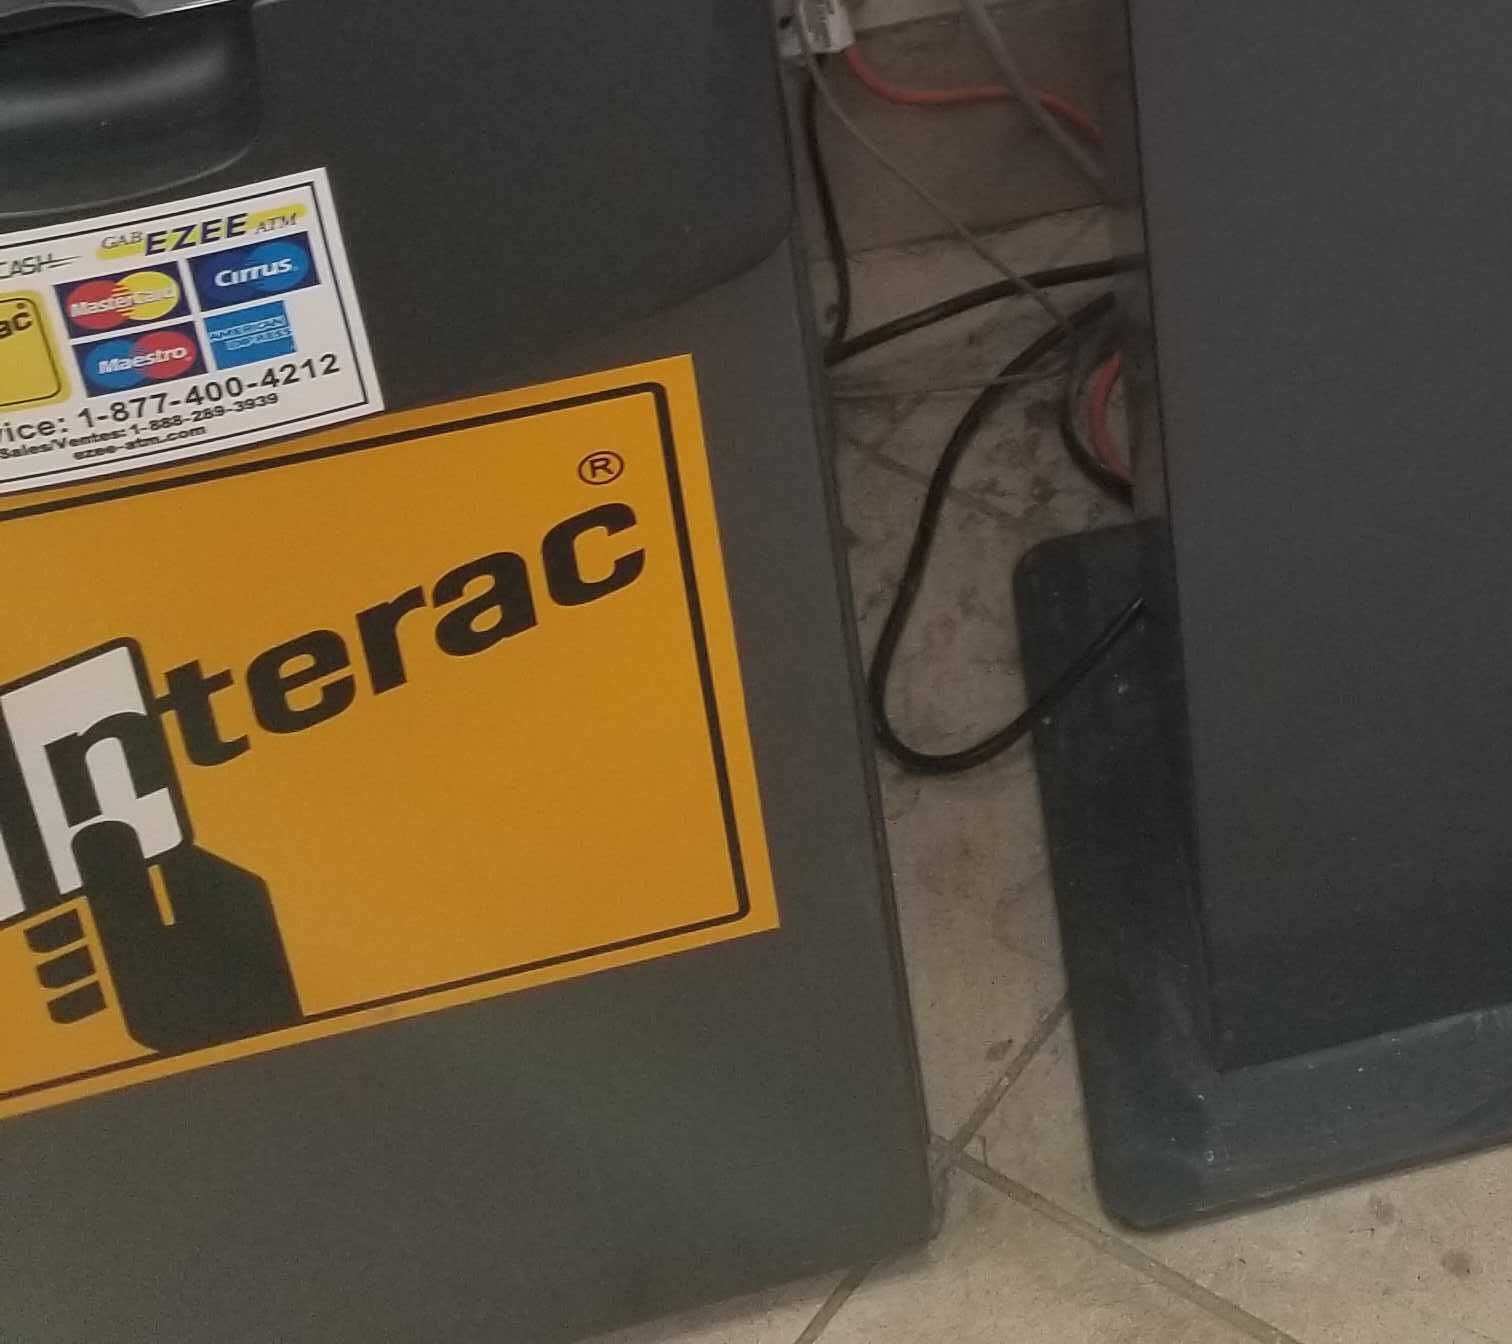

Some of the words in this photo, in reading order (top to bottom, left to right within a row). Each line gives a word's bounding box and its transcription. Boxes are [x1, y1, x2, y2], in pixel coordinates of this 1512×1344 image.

[101, 230, 144, 250] GAB
[144, 212, 249, 256] EZEE
[255, 211, 298, 234] ATM
[214, 257, 293, 287] Cirrus
[70, 287, 176, 318] MasterCard
[208, 314, 287, 341] AMERICAN
[97, 346, 189, 374] Maestro
[77, 353, 340, 429] 1-877-400-4212
[73, 425, 207, 461] ezee-atm.com
